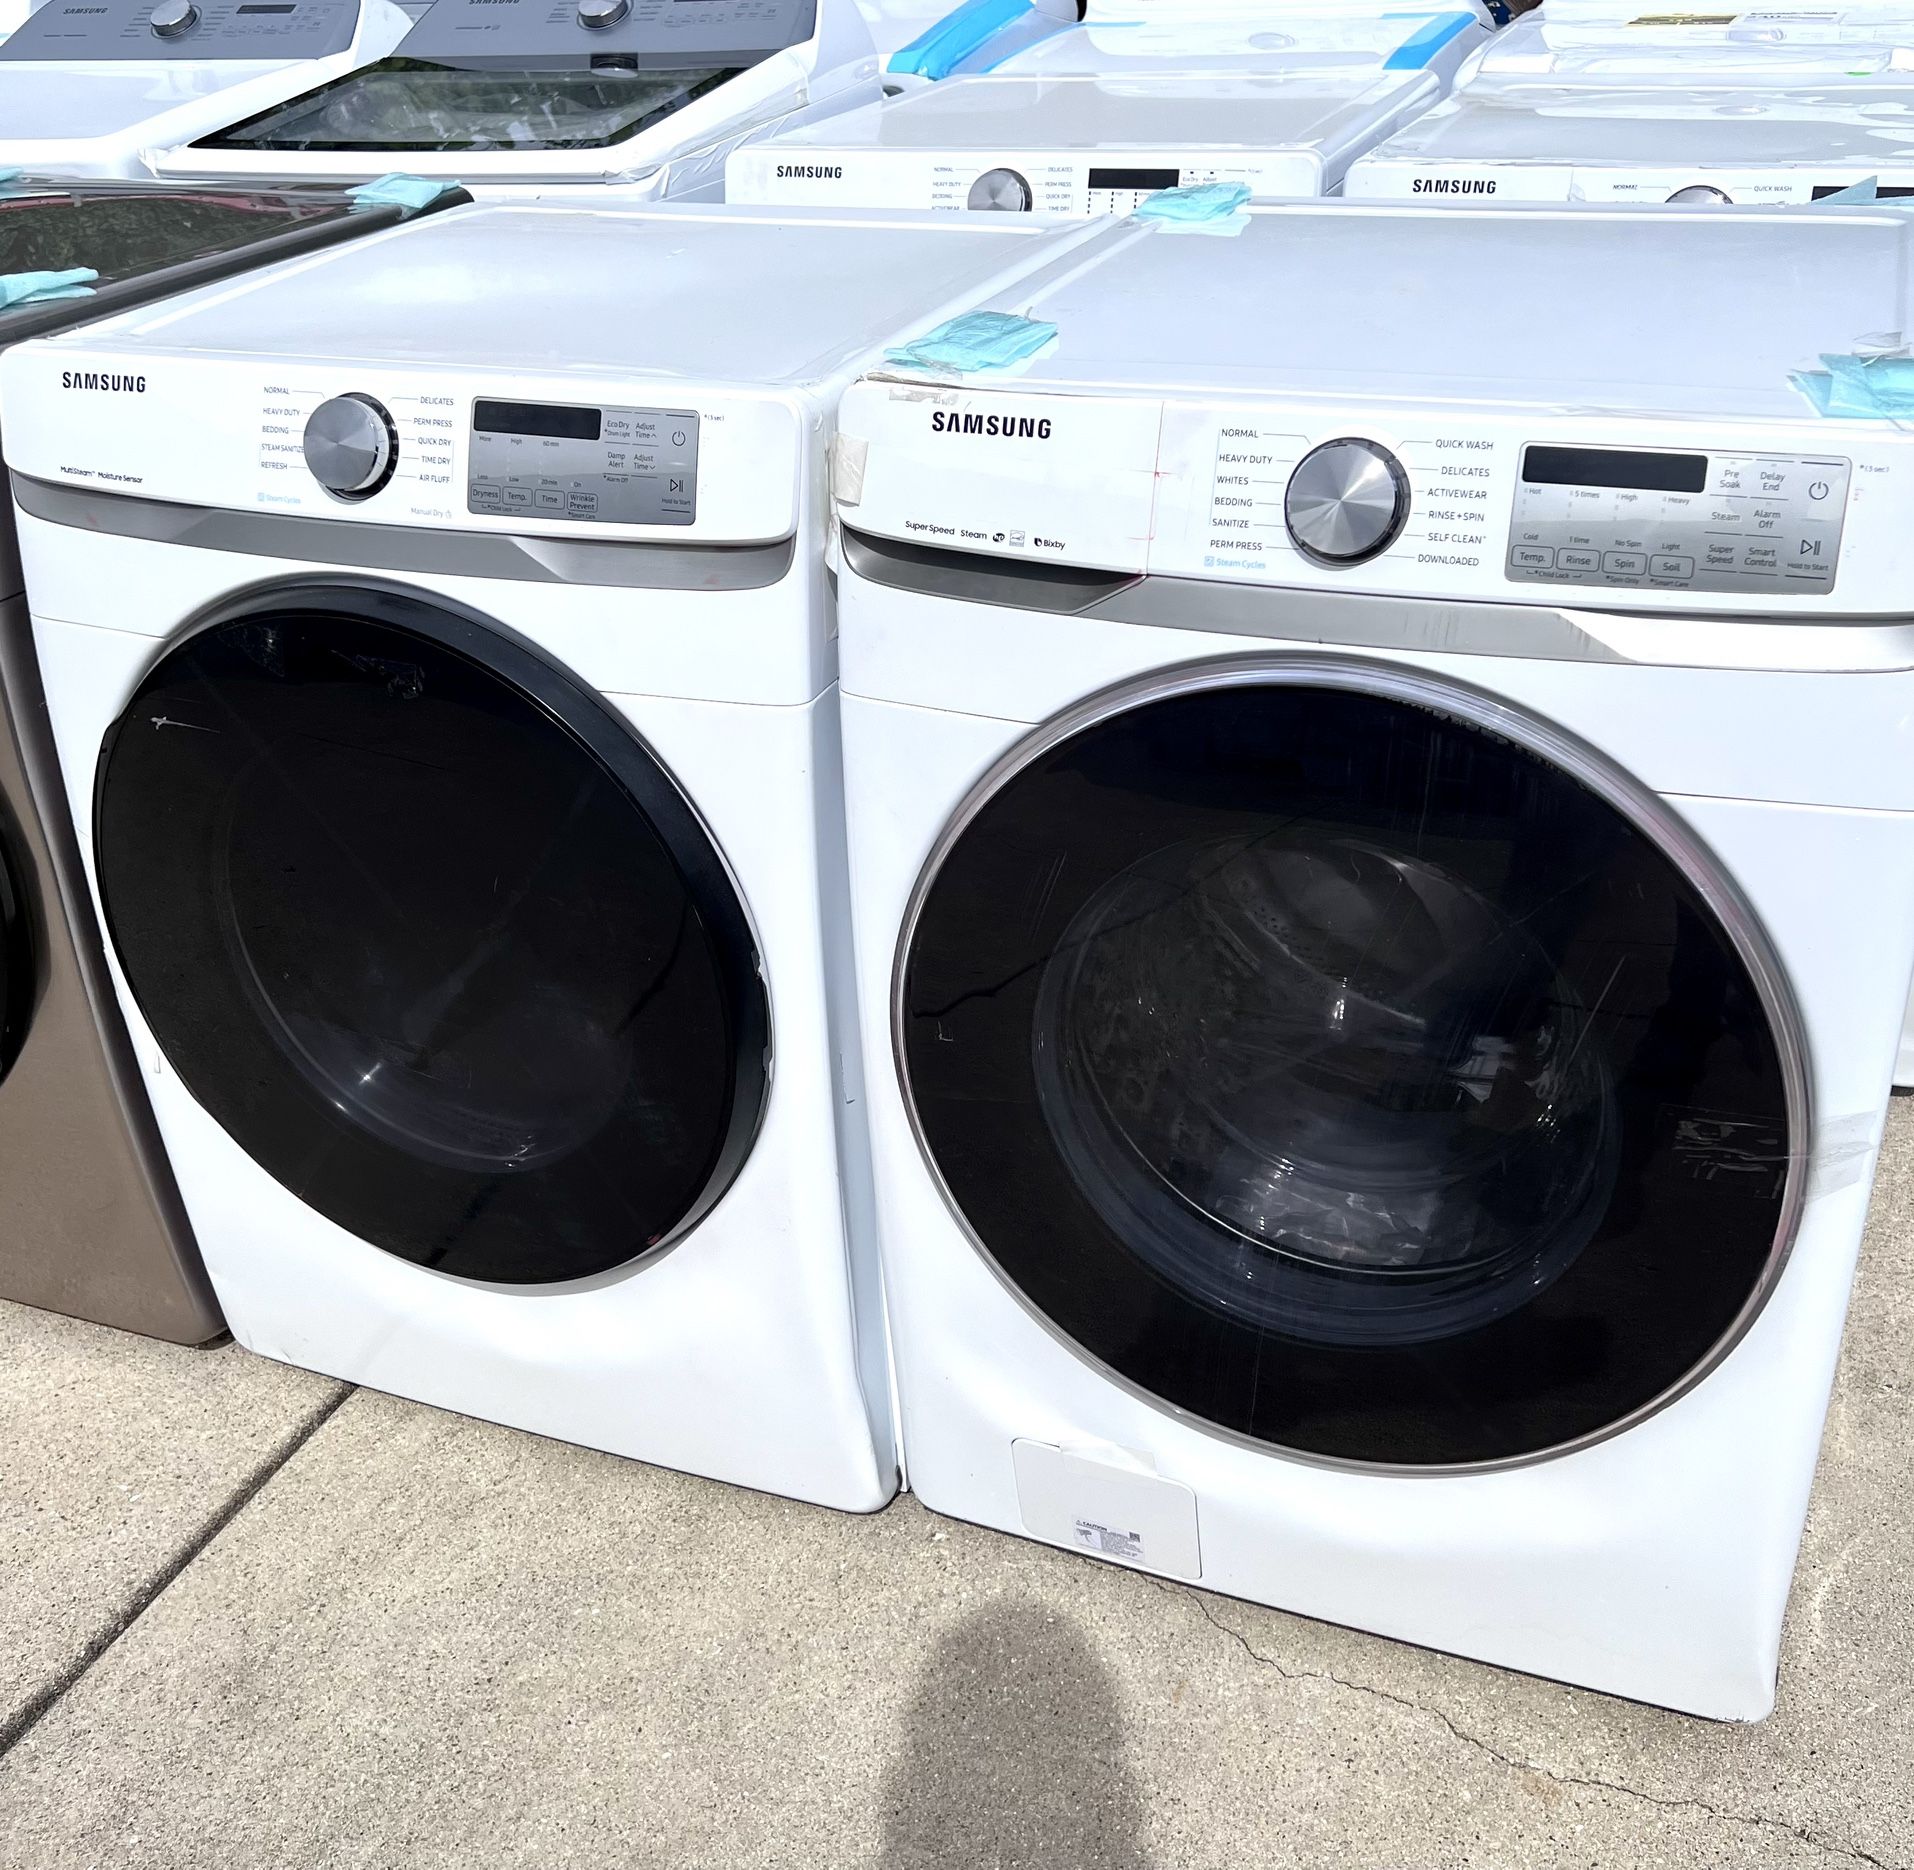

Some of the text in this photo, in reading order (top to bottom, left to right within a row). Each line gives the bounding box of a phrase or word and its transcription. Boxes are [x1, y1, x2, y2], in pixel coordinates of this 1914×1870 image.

[62, 7, 109, 15] SAMSUNG
[776, 165, 843, 179] SAMSUNG
[1412, 178, 1497, 195] SAMSUNG
[62, 371, 147, 393] SAMSUNG
[263, 386, 290, 395] NORMAL
[420, 396, 454, 406] DELICATES
[262, 407, 300, 416] HEAVY DUTY
[413, 417, 453, 428] PERM PRESS
[607, 420, 630, 430] Eco Dry
[635, 422, 656, 431] Adjust
[931, 411, 1052, 439] SAMSUNG
[262, 425, 289, 434] BEDDING
[1221, 428, 1259, 438] NORMAL
[635, 431, 650, 439] Time
[417, 437, 452, 447] QUICK DRY
[511, 438, 523, 446] High
[1435, 439, 1494, 450] QUICK WASH
[261, 443, 280, 452] STEAM
[421, 455, 451, 466] TIME DRY
[607, 452, 626, 461] Damp
[634, 454, 654, 462] Adjust
[1218, 454, 1273, 464] HEAVY DUTY
[261, 461, 288, 470] REFRESH
[608, 460, 624, 468] Alert
[634, 462, 649, 470] Time
[1441, 466, 1490, 477] DELICATES
[1724, 469, 1740, 478] Pre
[97, 472, 122, 482] Moisture
[122, 475, 143, 484] Sensor
[419, 474, 451, 484] AIR FLUFF
[1216, 476, 1249, 485] WHITES
[1760, 471, 1786, 483] Delay
[1719, 479, 1741, 490] Soak
[1762, 482, 1780, 492] End
[472, 488, 499, 499] Dryness
[1427, 488, 1488, 499] ACTIVEWEAR
[1529, 487, 1542, 495] Hot
[1580, 491, 1600, 499] times
[507, 492, 528, 502] Temp.
[542, 494, 558, 504] Time
[570, 494, 595, 503] Wrinkle
[1214, 497, 1253, 507] BEDDING
[1620, 493, 1638, 502] High
[1667, 496, 1690, 506] Heavy
[569, 502, 595, 511] Prevent
[411, 507, 444, 518] Manual Dry
[1711, 511, 1741, 521] Steam
[1753, 509, 1781, 519] Alarm
[905, 520, 955, 536] Super Speed
[1212, 518, 1250, 528] SANITIZE
[1758, 519, 1774, 529] Off
[960, 529, 988, 540] Steam
[1428, 532, 1450, 542] SELF
[1523, 532, 1539, 541] Cold
[1043, 539, 1066, 551] Bixby
[1573, 536, 1590, 544] time
[1615, 539, 1643, 549] No Spin
[1210, 540, 1263, 551] PERM PRESS
[1661, 542, 1681, 551] Light
[1708, 544, 1735, 556] Super
[1520, 551, 1547, 563] Temp.
[1748, 547, 1776, 557] Smart
[1216, 558, 1266, 569] Steam Cycles
[1418, 554, 1480, 567] DOWNLOADED
[1565, 555, 1592, 566] Rinse
[1614, 558, 1636, 569] Spin
[1706, 555, 1735, 566] Speed
[1744, 557, 1777, 569] Control
[1662, 561, 1681, 572] Soil
[1787, 562, 1803, 570] Hold
[1812, 563, 1829, 572] Start
[1555, 571, 1570, 580] Lock
[1626, 576, 1640, 586] Only
